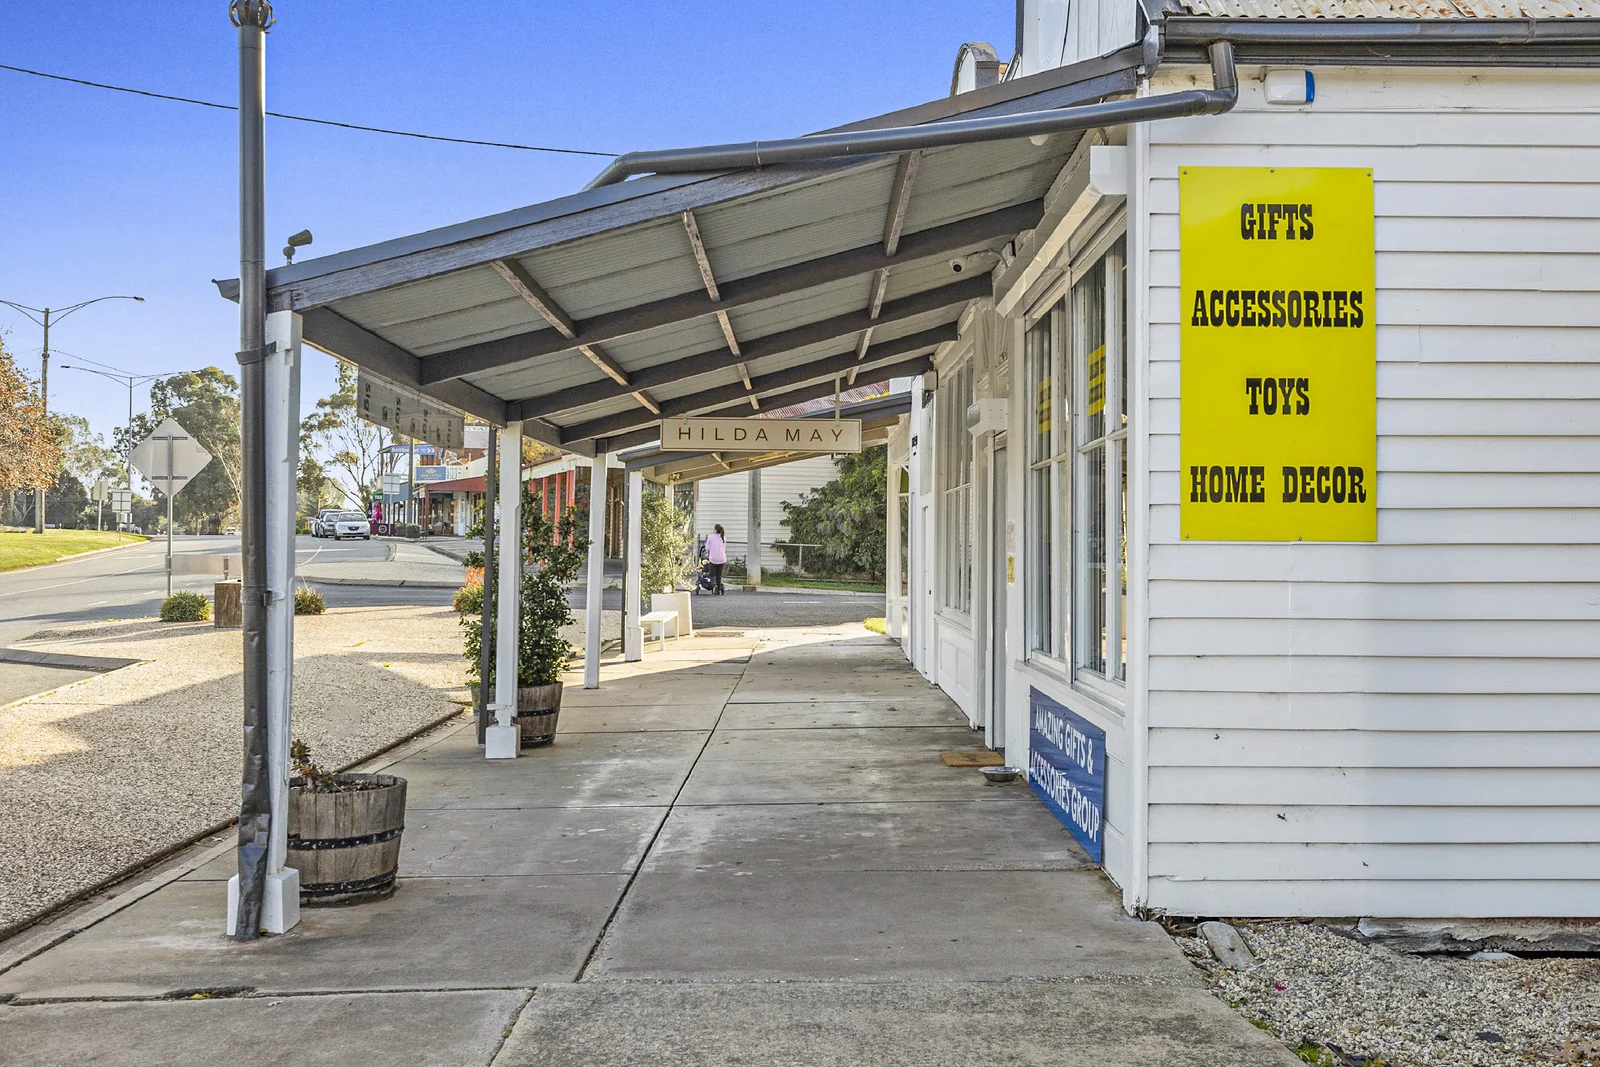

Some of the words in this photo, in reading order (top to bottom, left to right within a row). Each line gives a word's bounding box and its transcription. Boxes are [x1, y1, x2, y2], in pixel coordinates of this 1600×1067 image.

[1240, 203, 1314, 241] GIFTS
[1191, 289, 1364, 328] ACCESSORIES
[1245, 377, 1310, 416] TOYS
[678, 427, 768, 441] HILDA
[786, 428, 843, 442] MAY
[1190, 465, 1265, 503] HOME
[1282, 465, 1366, 504] DECOR
[1035, 703, 1064, 751] AMAZING
[1065, 723, 1086, 769] GIFTS
[1086, 738, 1094, 775] &
[1030, 748, 1070, 815] ACCESSORIES
[1070, 787, 1100, 843] GROUP
